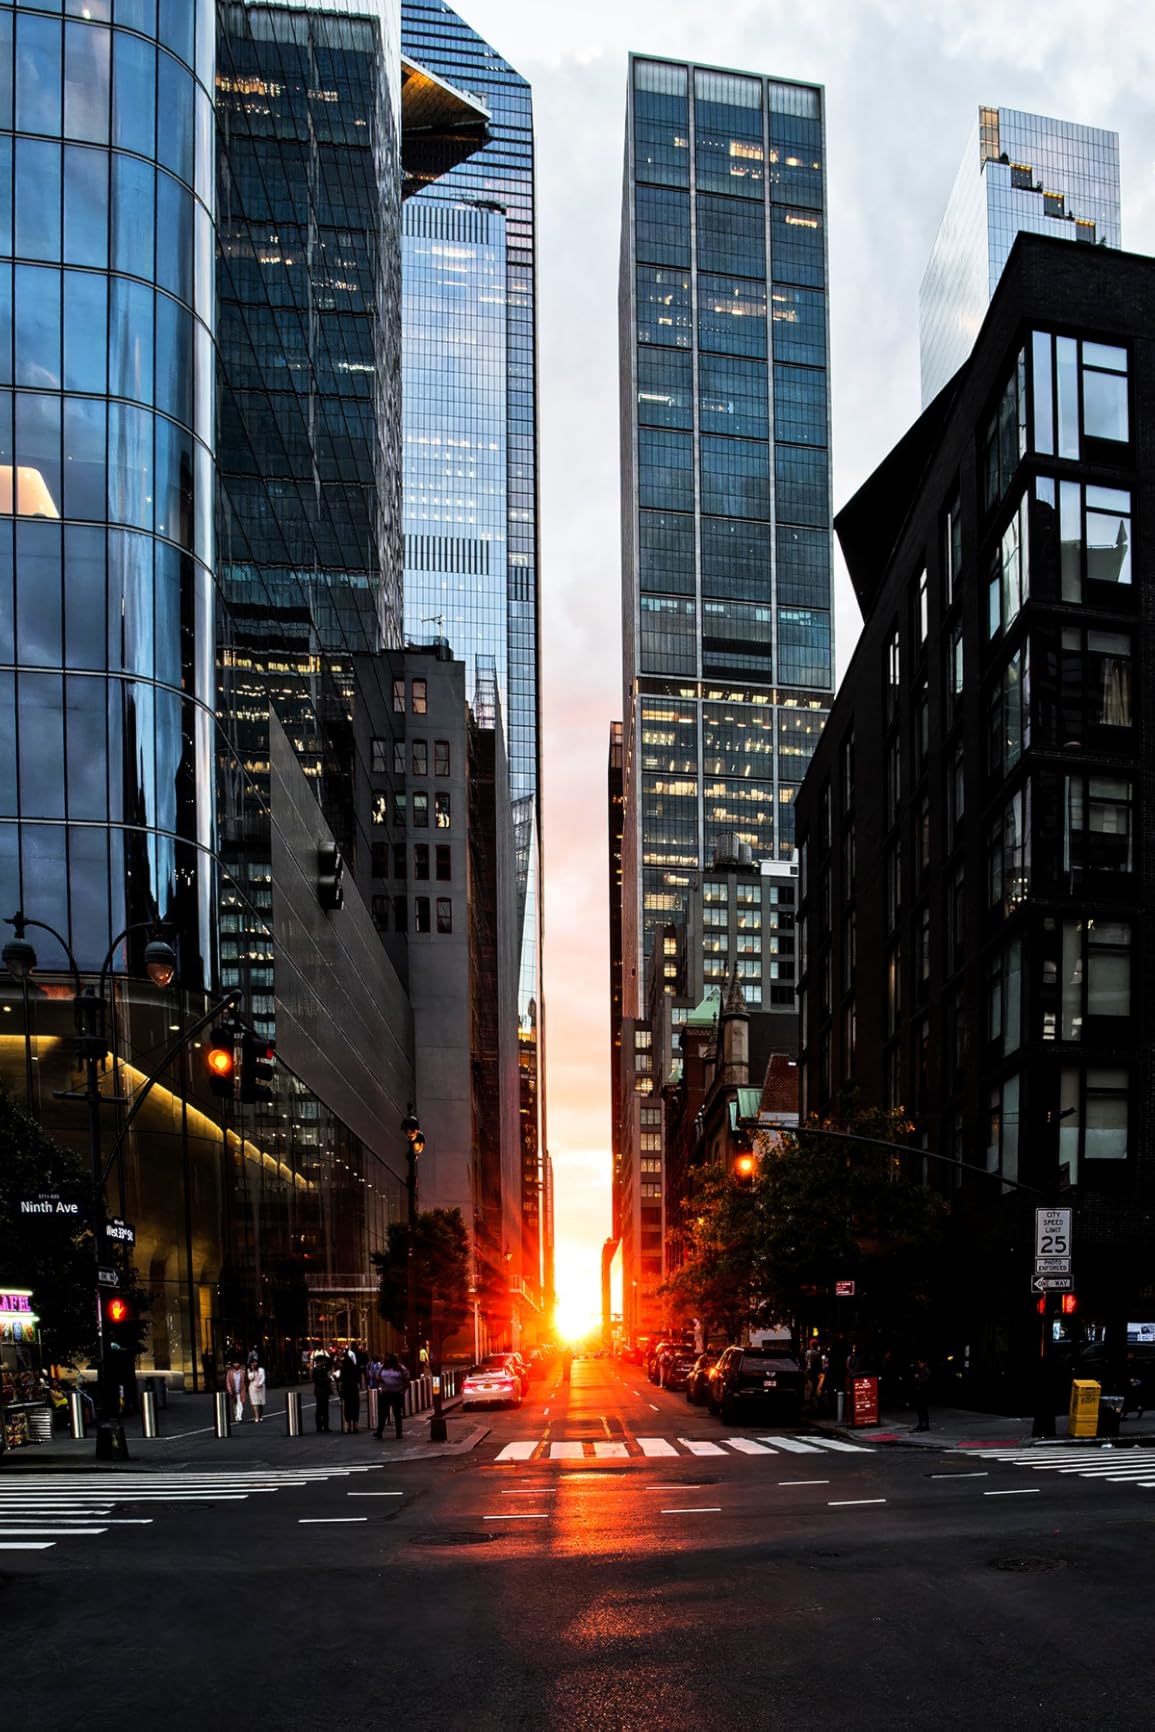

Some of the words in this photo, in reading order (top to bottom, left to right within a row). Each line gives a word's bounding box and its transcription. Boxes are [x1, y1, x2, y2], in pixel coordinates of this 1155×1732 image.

[20, 1200, 53, 1213] Ninth
[55, 1201, 79, 1213] Ave
[1041, 1236, 1066, 1253] 25
[0, 1295, 31, 1311] AFEL
